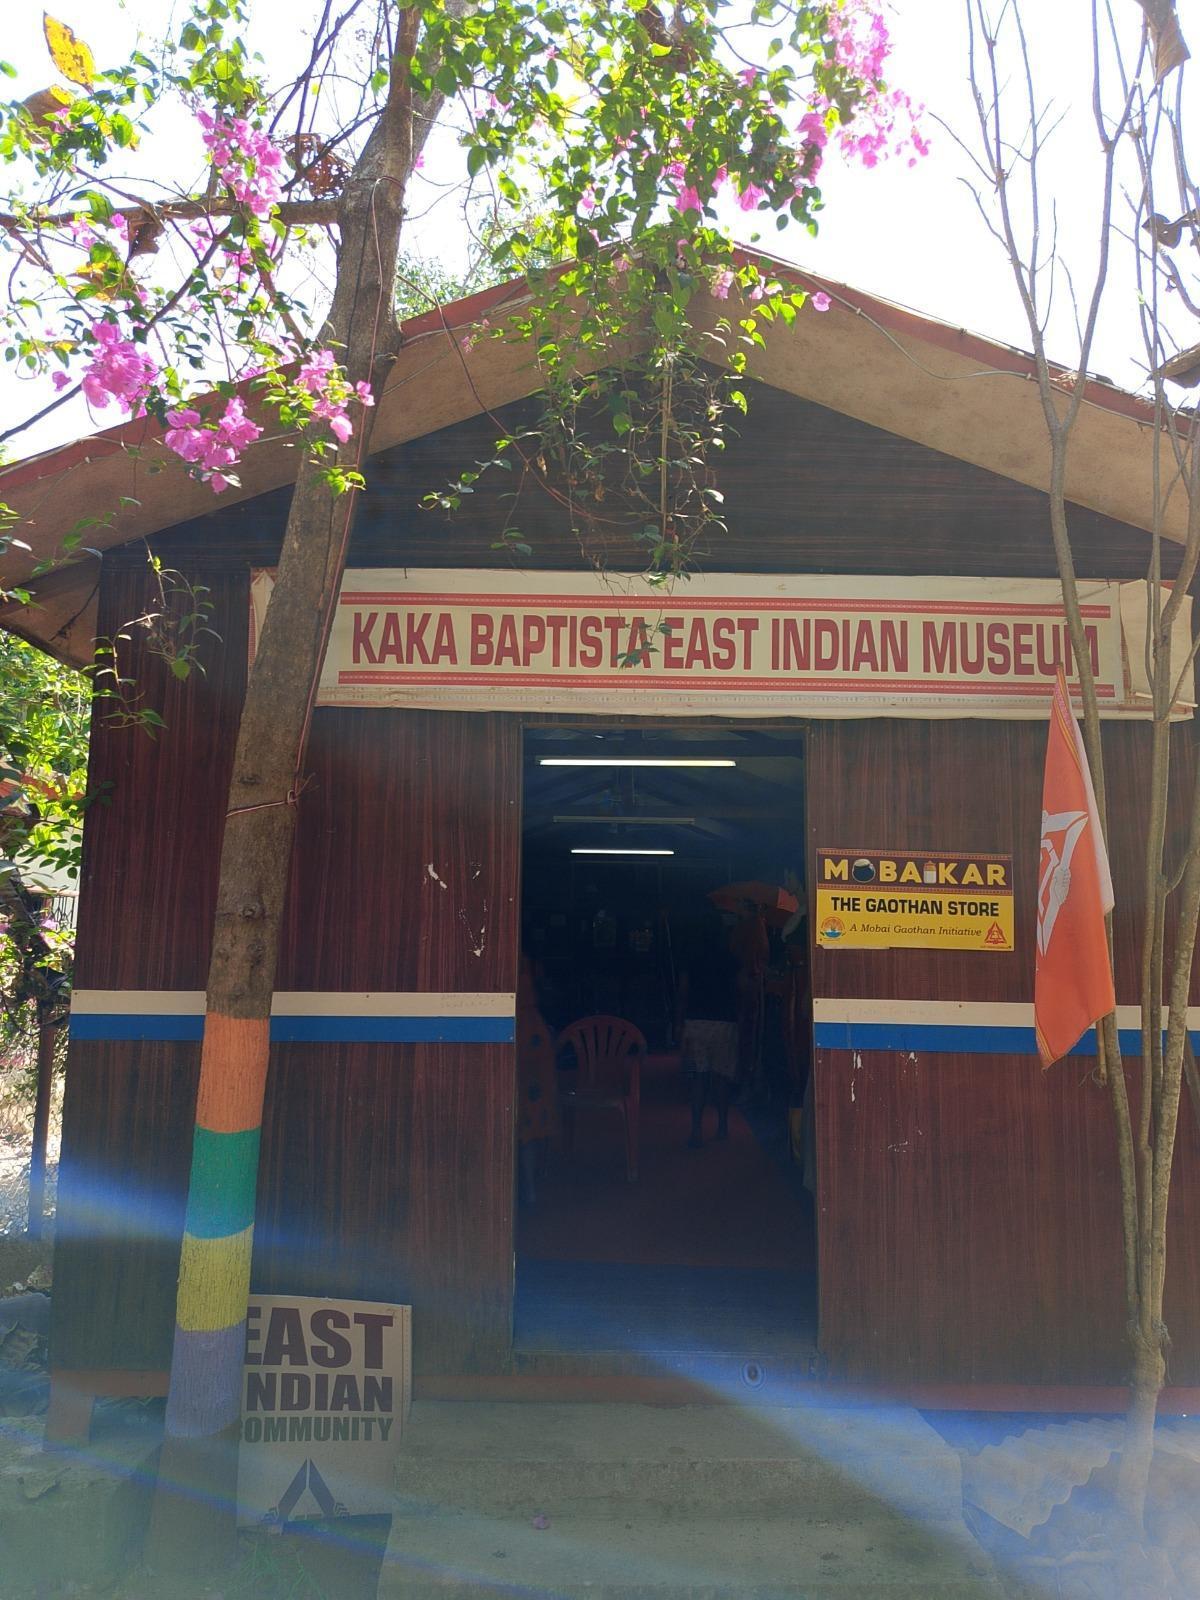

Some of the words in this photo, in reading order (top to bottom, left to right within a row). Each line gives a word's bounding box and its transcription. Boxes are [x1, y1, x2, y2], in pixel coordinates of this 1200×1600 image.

[352, 612, 458, 665] KAKA
[470, 613, 652, 669] BAPTISTA
[663, 616, 760, 671] EAST
[771, 617, 909, 673] INDIAN
[922, 620, 1100, 677] MUSEUM
[831, 896, 861, 912] THE
[865, 898, 943, 915] GAOTHAN
[947, 900, 1000, 917] STORE
[849, 923, 858, 932] A
[860, 923, 891, 933] Mobai
[893, 925, 936, 935] Gaothan
[938, 926, 982, 937] Initiative
[244, 1306, 394, 1370] EAST
[246, 1372, 393, 1413] NDIAN
[239, 1416, 394, 1443] OMMUNITY
